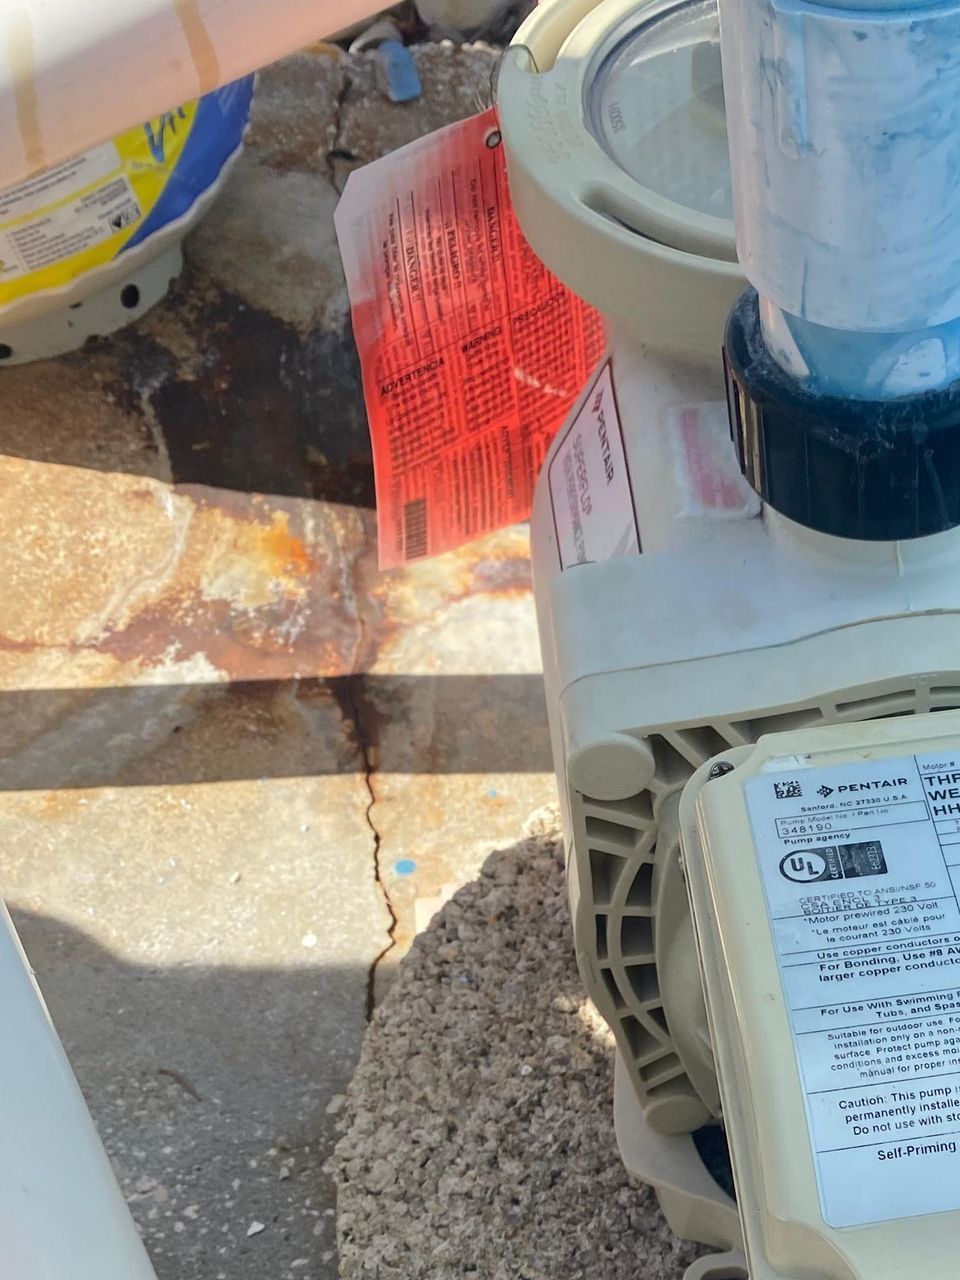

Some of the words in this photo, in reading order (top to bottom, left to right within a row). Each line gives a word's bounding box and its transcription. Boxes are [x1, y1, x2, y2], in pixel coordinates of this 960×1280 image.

[405, 246, 419, 294] DANGER
[379, 356, 446, 396] ADVERTENCIA
[597, 411, 616, 485] PENTAIR
[922, 762, 947, 770] Motor
[837, 777, 907, 793] PENTAIR
[782, 822, 832, 835] 348190
[783, 837, 813, 845] Pump
[815, 830, 850, 842] agency
[790, 857, 819, 876] UL
[843, 907, 890, 922] prewired
[893, 904, 914, 914] 230
[916, 901, 938, 910] Volt
[842, 946, 881, 956] copper
[885, 937, 950, 950] conductors
[819, 963, 840, 971] For
[902, 952, 925, 960] Use
[928, 948, 943, 957] #8
[819, 972, 854, 981] larger
[858, 965, 901, 977] copper
[820, 1008, 839, 1016] For
[842, 1005, 864, 1013] Use
[866, 1000, 892, 1010] With
[895, 993, 953, 1006] Swimming
[910, 1004, 931, 1014] and
[827, 1030, 866, 1040] Suitable
[885, 1022, 922, 1032] outdoor
[875, 1043, 911, 1054] Protect
[913, 1040, 940, 1050] pump
[830, 1058, 881, 1071] conditions
[885, 1054, 902, 1063] and
[905, 1050, 939, 1060] excess
[859, 1066, 894, 1077] manual
[913, 1060, 945, 1072] proper
[890, 1092, 916, 1102] This
[919, 1087, 952, 1100] pump
[845, 1104, 916, 1124] permanently
[852, 1125, 869, 1135] Do
[872, 1121, 891, 1132] not
[894, 1120, 915, 1129] use
[917, 1114, 942, 1126] with
[877, 1141, 956, 1160] Self-Priming
